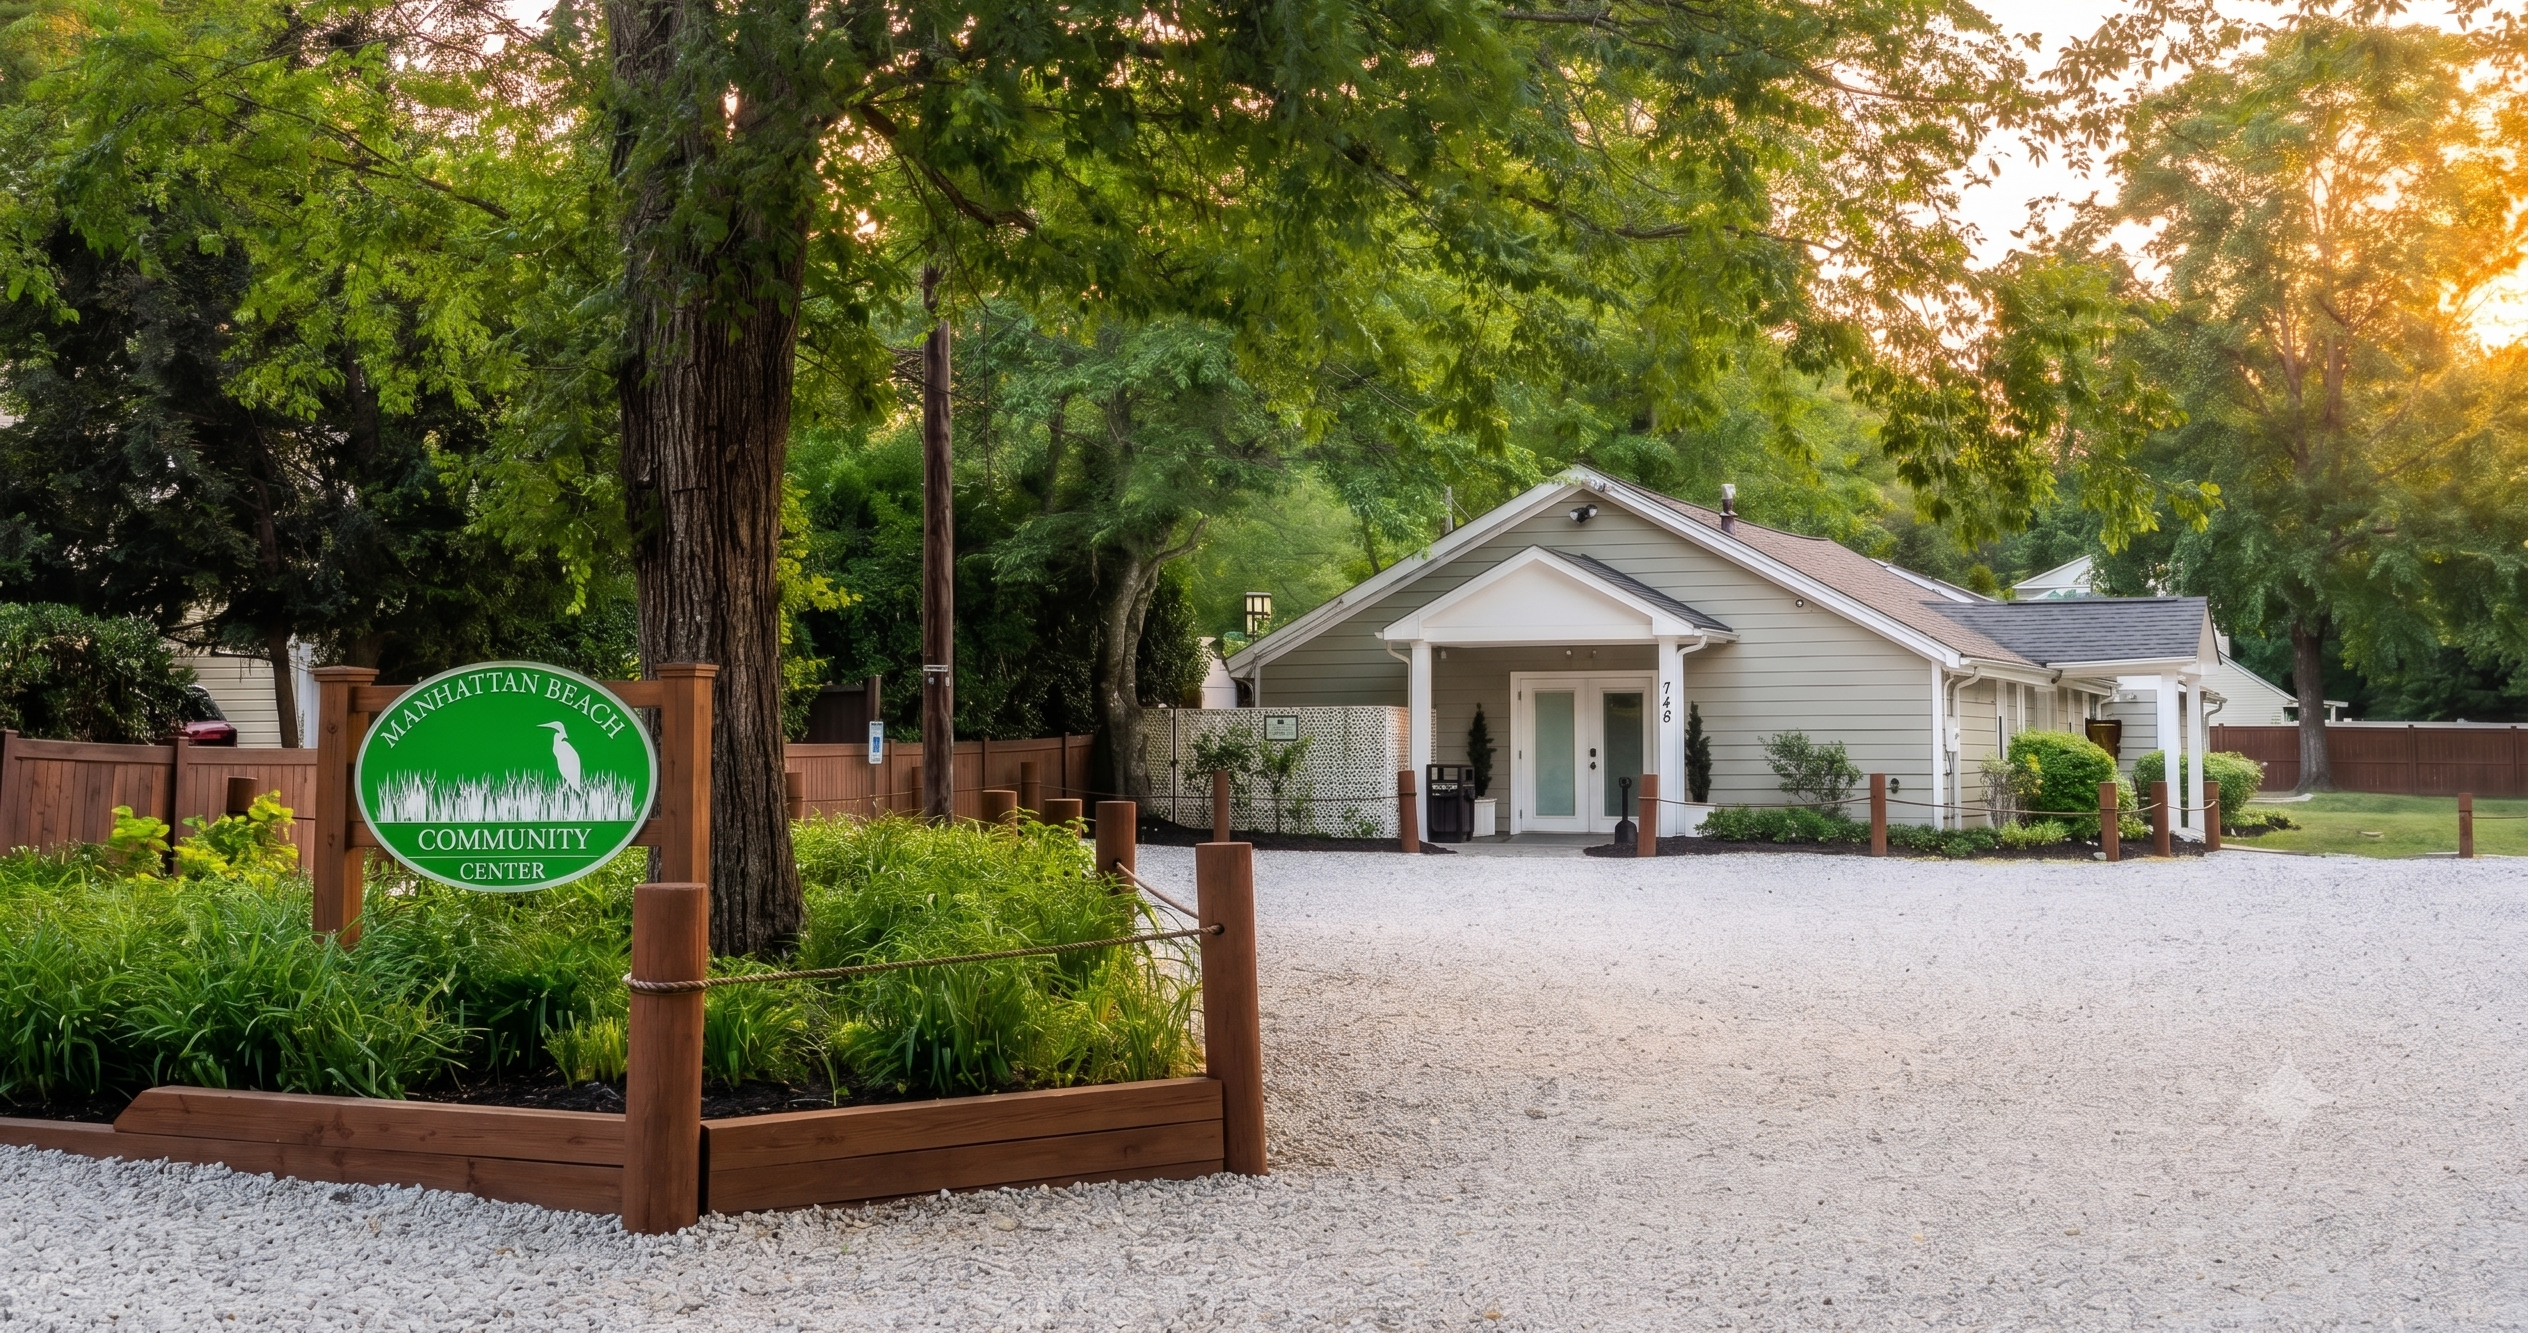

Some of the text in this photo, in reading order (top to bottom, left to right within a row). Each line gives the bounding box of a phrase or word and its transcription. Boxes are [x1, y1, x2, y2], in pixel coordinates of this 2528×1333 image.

[380, 672, 626, 748] MANHATTAN BEACH
[1662, 681, 1671, 723] 746
[417, 828, 592, 851] COMMUNITY
[459, 862, 546, 880] CENTER
